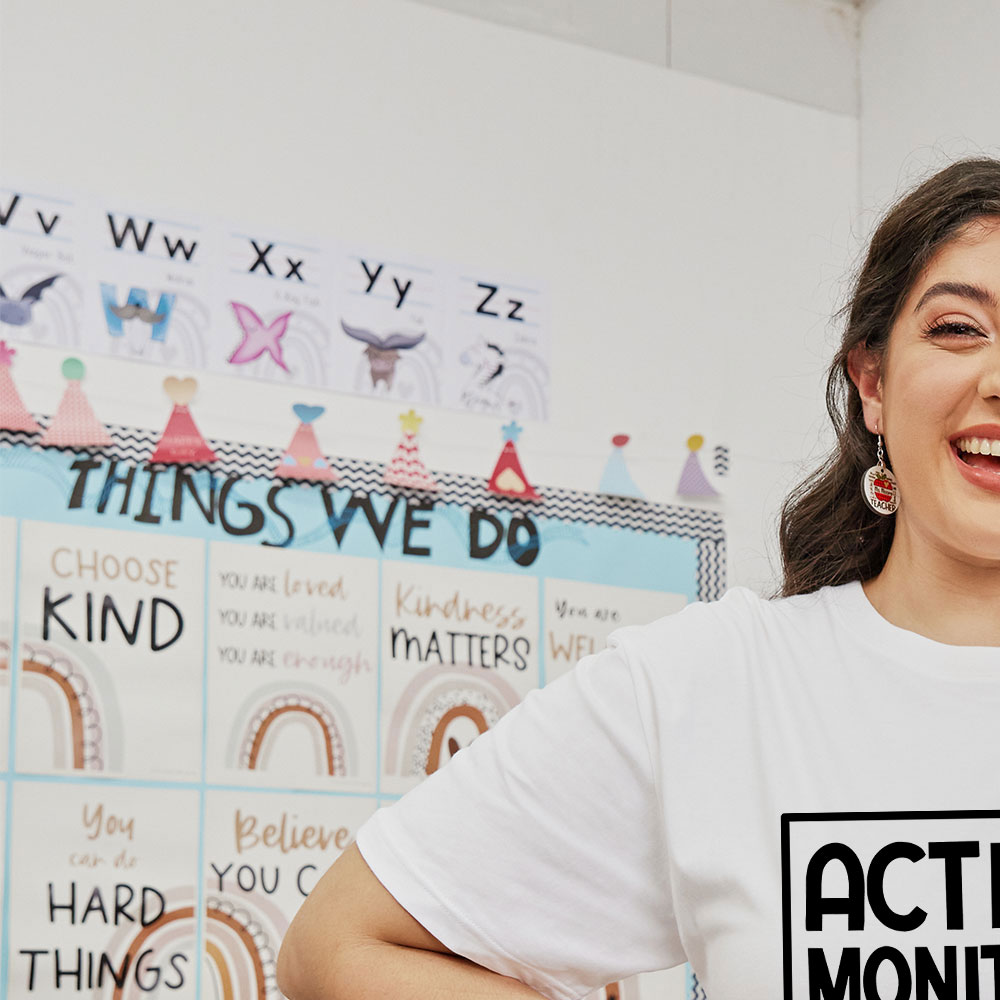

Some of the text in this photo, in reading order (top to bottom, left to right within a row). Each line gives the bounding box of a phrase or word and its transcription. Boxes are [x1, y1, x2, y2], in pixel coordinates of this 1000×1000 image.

[67, 460, 541, 567] THINGS WE DO
[51, 548, 178, 589] CHOOSE
[218, 571, 248, 590] YOU
[283, 568, 347, 601] loved
[43, 586, 184, 651] KIND
[218, 608, 248, 628] YOU
[396, 581, 526, 630] Kindness
[218, 645, 248, 666] YOU
[283, 652, 371, 686] enough
[391, 626, 531, 671] MATTERS
[83, 803, 135, 841] You
[234, 809, 350, 854] Believe
[211, 863, 279, 894] YOU
[48, 882, 166, 927] HARD
[19, 948, 188, 992] THINGS
